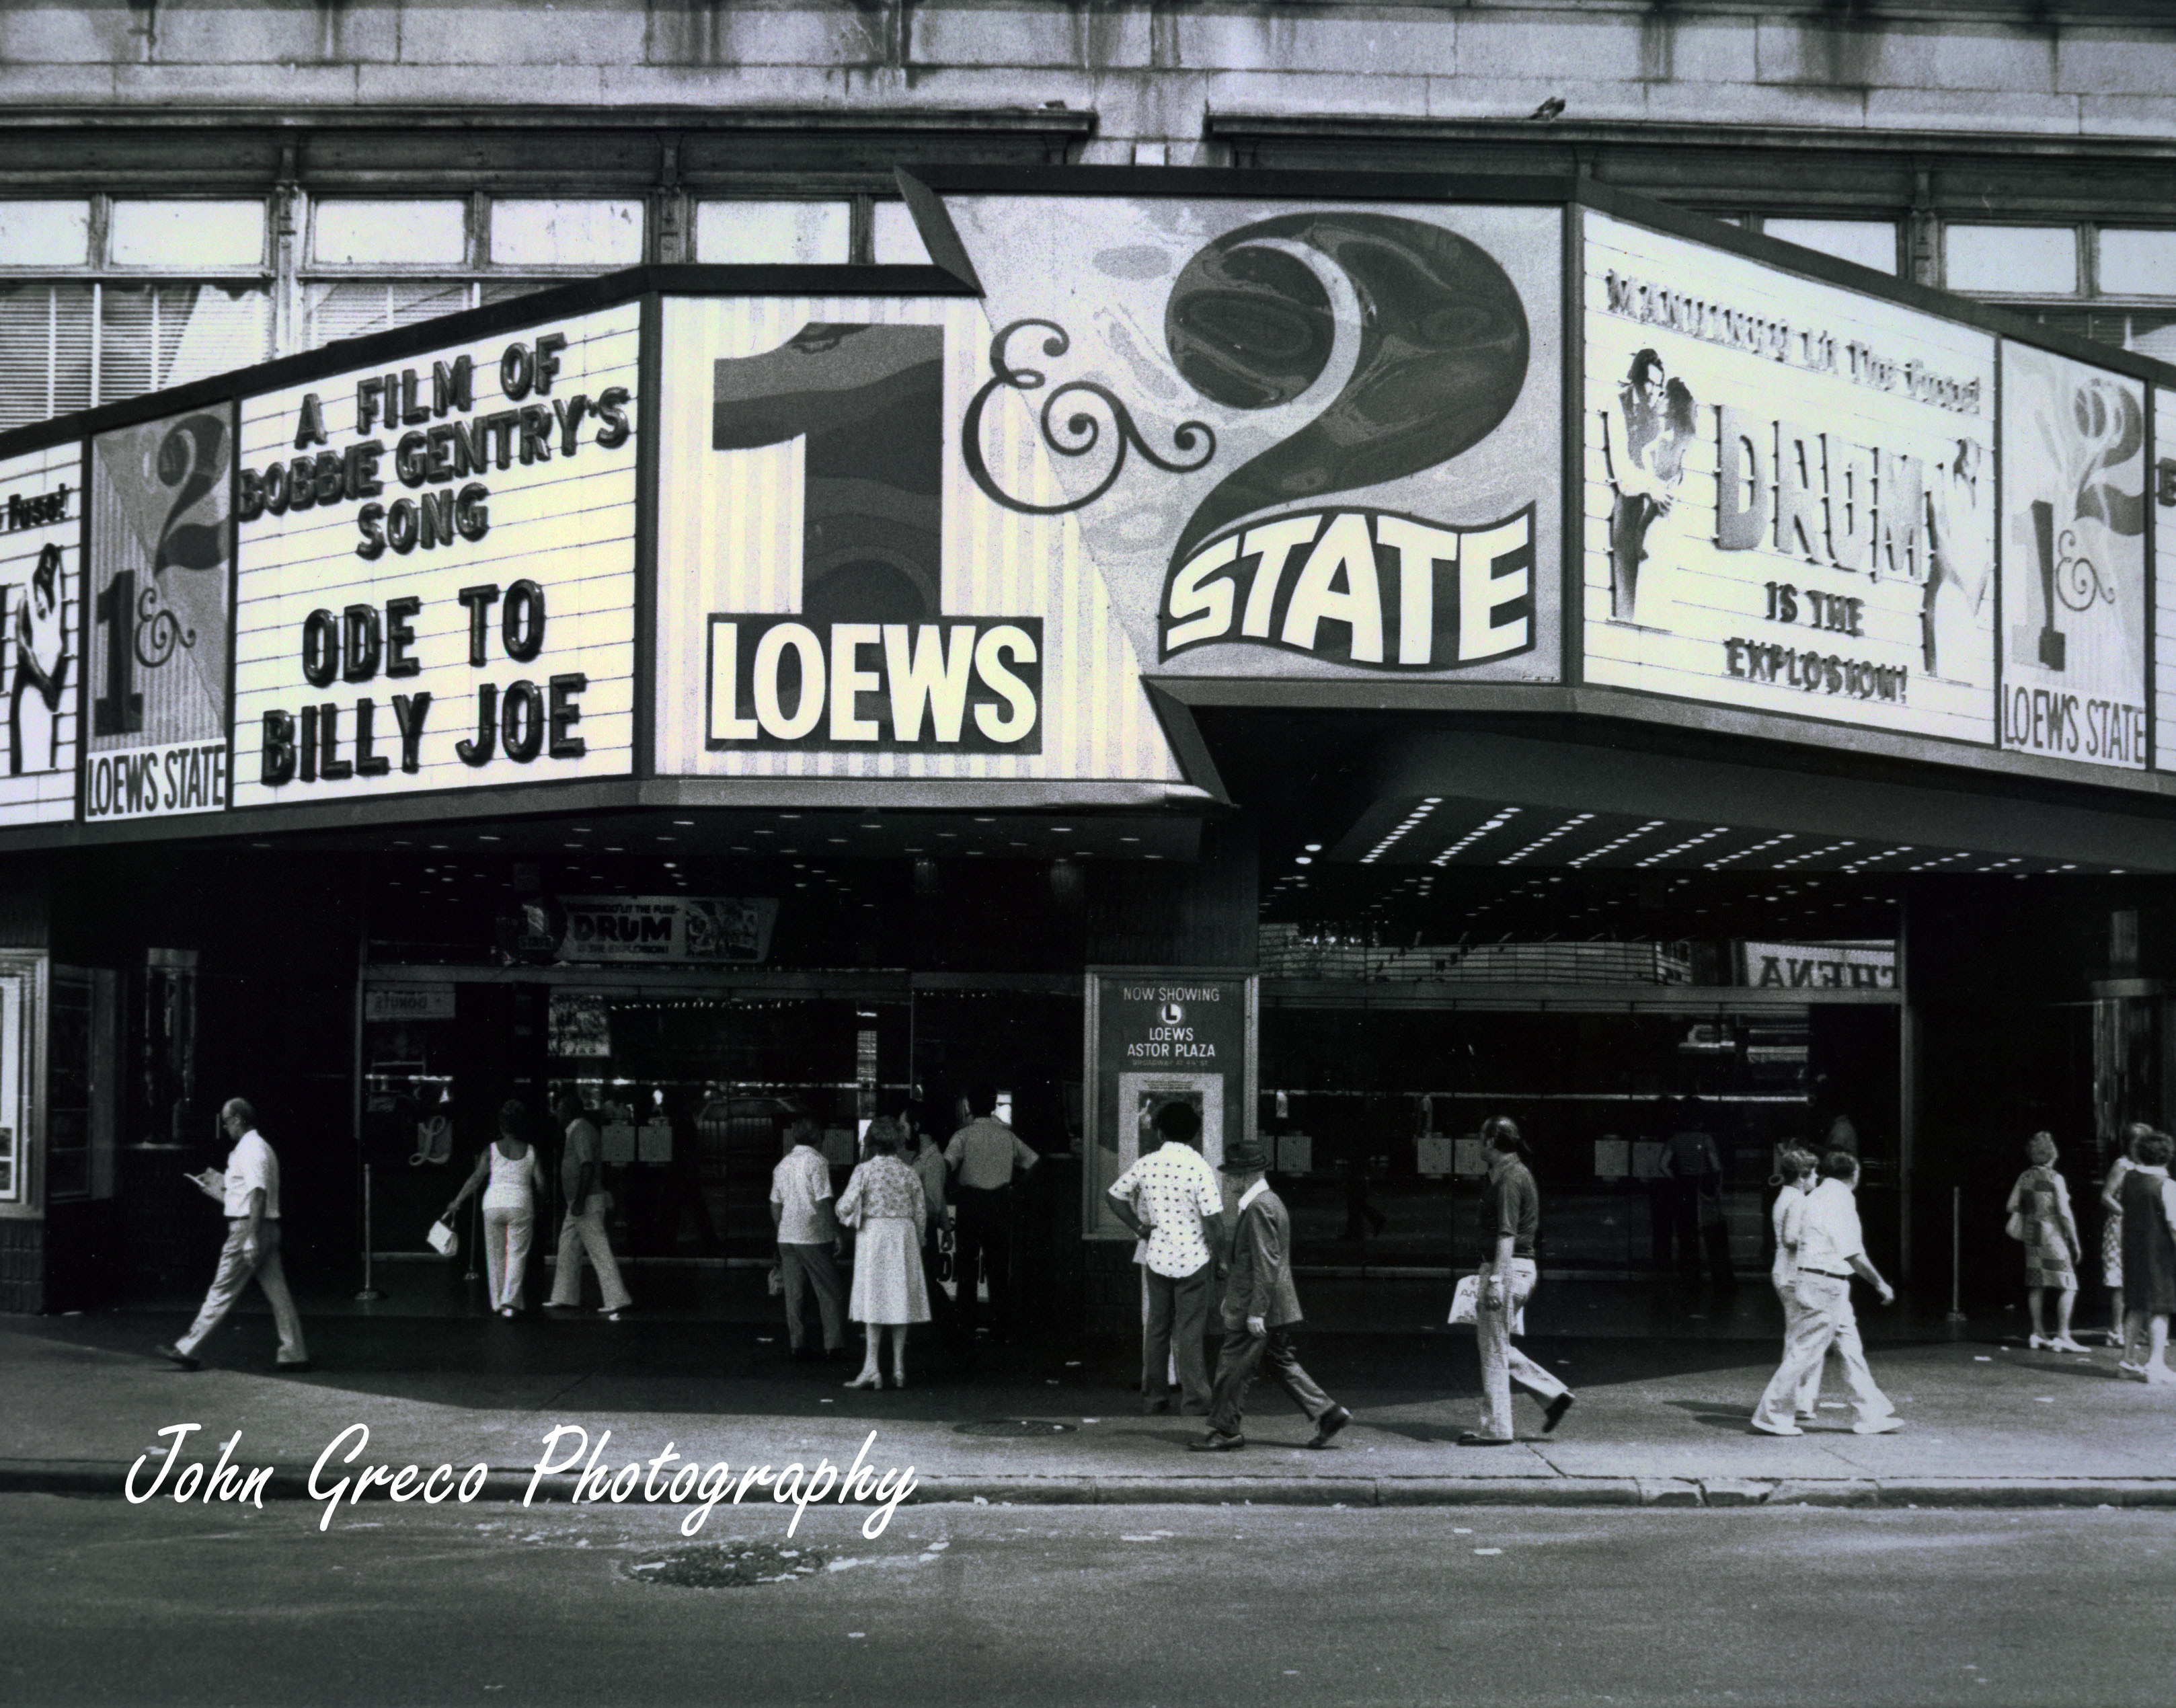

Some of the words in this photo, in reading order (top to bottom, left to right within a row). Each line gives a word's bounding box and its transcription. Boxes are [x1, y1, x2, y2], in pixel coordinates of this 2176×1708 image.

[295, 393, 328, 449] A
[357, 354, 473, 435] FILM
[500, 332, 568, 401] OF
[238, 440, 385, 522] BOBBIE
[395, 386, 630, 488] GENTRY'S
[962, 318, 1216, 514] &
[1159, 210, 1537, 669] 2
[2074, 379, 2144, 537] 2
[155, 414, 229, 576] 2
[355, 482, 490, 561] SONG
[1714, 404, 1923, 583] DRUM
[1765, 581, 1797, 623] IS
[1806, 590, 1865, 637] THE
[2012, 500, 2066, 671] 1
[2056, 529, 2115, 612] &
[94, 569, 143, 737] 1
[134, 586, 196, 668] &
[303, 596, 422, 688] ODE
[459, 578, 546, 668] TO
[711, 622, 1038, 744] LOEWS
[1167, 513, 1528, 666] STATE
[1723, 636, 1908, 705] EXPLOSION!
[261, 691, 432, 787] BILLY
[455, 672, 587, 767] JOE
[2004, 683, 2080, 756] LOEWS
[2086, 698, 2146, 764] STATE
[87, 751, 159, 817] LOEWS
[165, 744, 226, 811] STATE
[574, 915, 672, 942] DRUM
[1123, 987, 1155, 1001] NOW
[1159, 987, 1220, 1002] SHOWING
[1149, 1027, 1194, 1042] LOEWS
[1163, 1003, 1179, 1022] L
[1127, 1044, 1170, 1058] ASTOR
[1175, 1044, 1216, 1058] PLAZA
